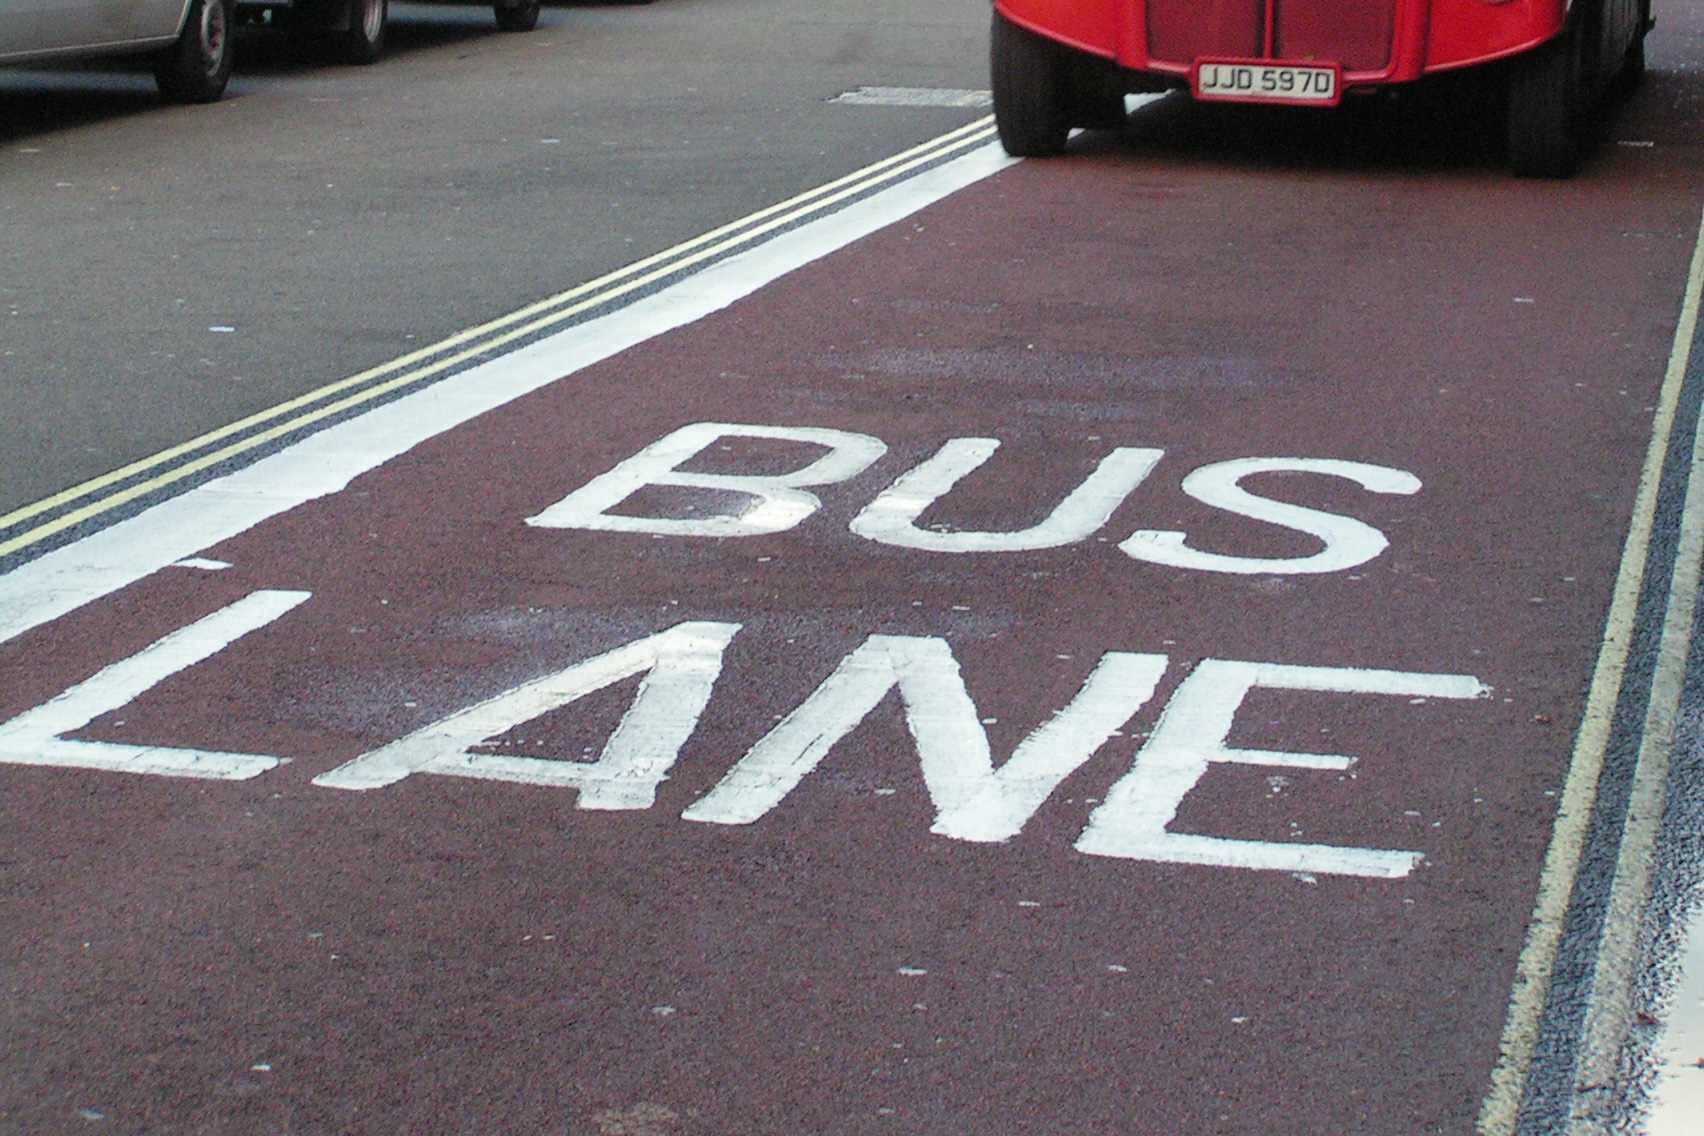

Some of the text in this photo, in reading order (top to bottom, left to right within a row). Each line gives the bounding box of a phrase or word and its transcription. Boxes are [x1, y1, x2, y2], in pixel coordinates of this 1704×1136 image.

[1203, 67, 1253, 90] JJD
[525, 421, 1423, 574] BUS
[0, 589, 1488, 878] LANE
